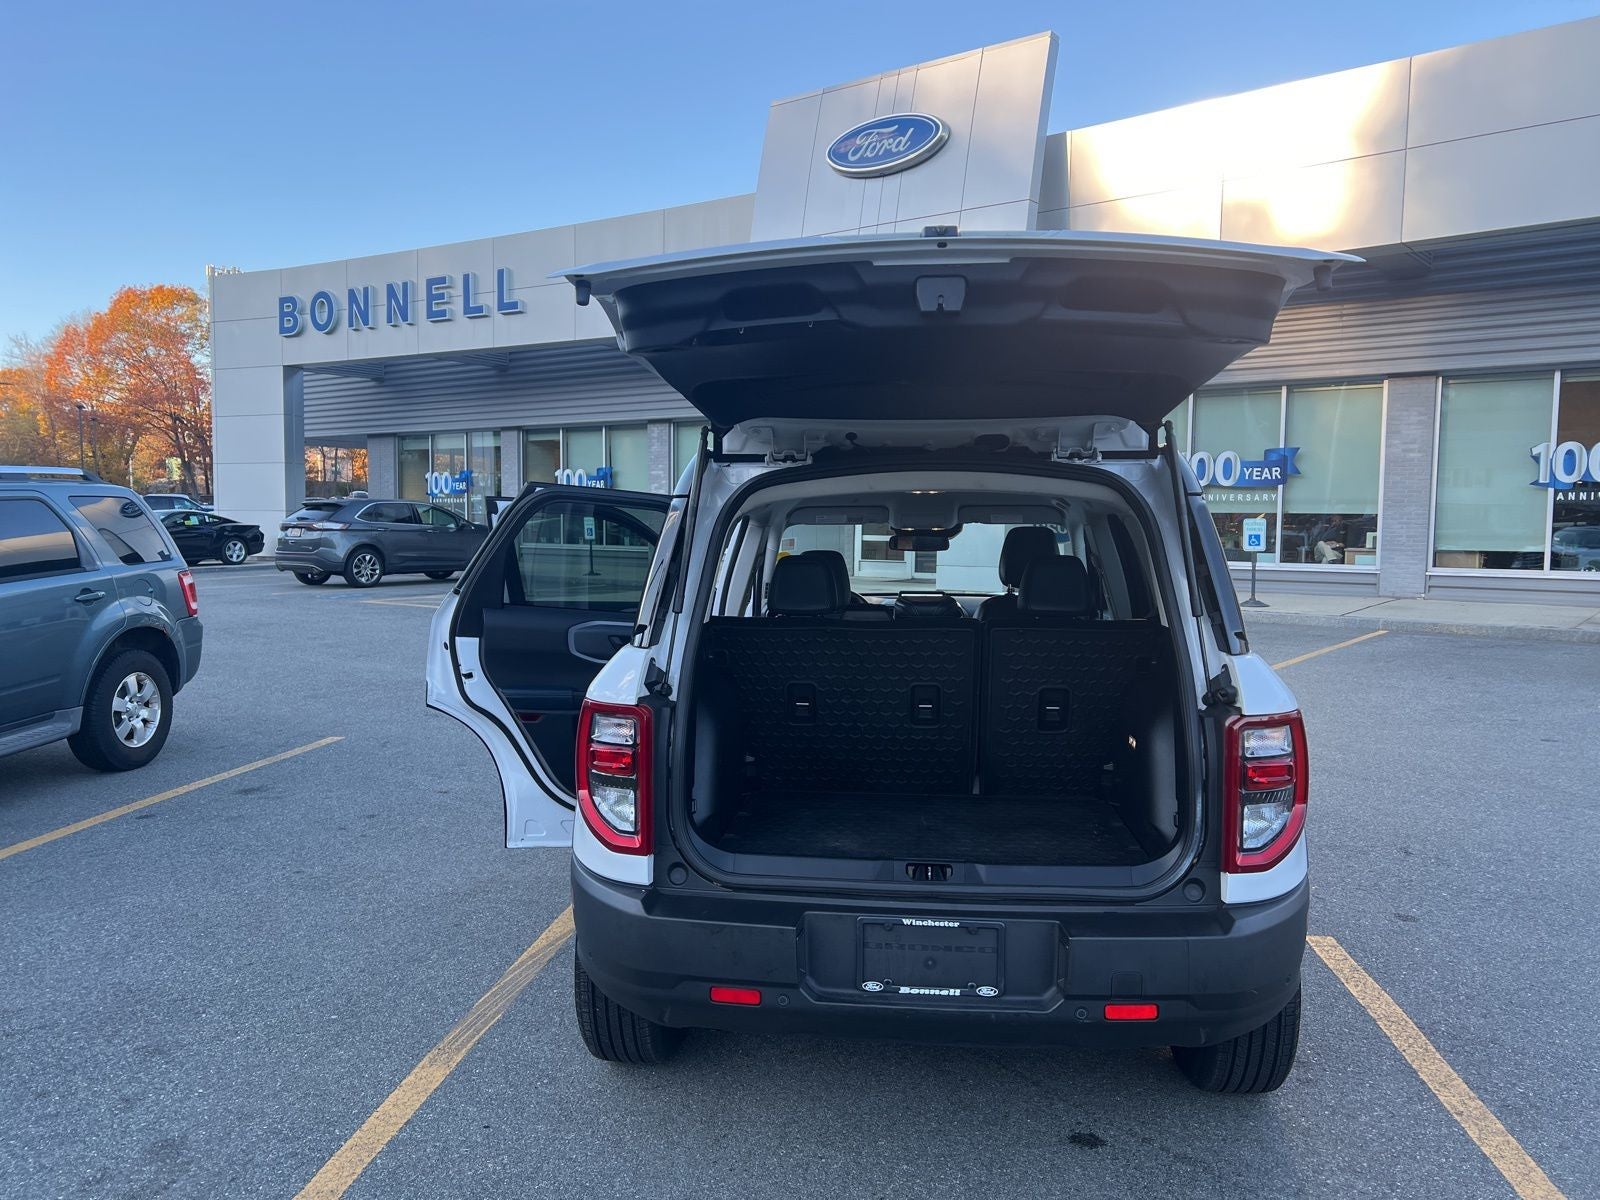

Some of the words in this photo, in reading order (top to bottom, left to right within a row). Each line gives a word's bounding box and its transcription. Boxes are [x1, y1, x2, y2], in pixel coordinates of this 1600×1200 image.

[848, 125, 914, 162] Ford
[278, 266, 525, 337] BONNELL
[1189, 450, 1241, 487] 00
[1243, 466, 1282, 480] YEAR
[425, 471, 452, 495] 100
[452, 481, 467, 490] YEAR
[1556, 491, 1600, 501] ANNI
[901, 918, 960, 928] Winchester
[899, 986, 961, 996] Bonnell
